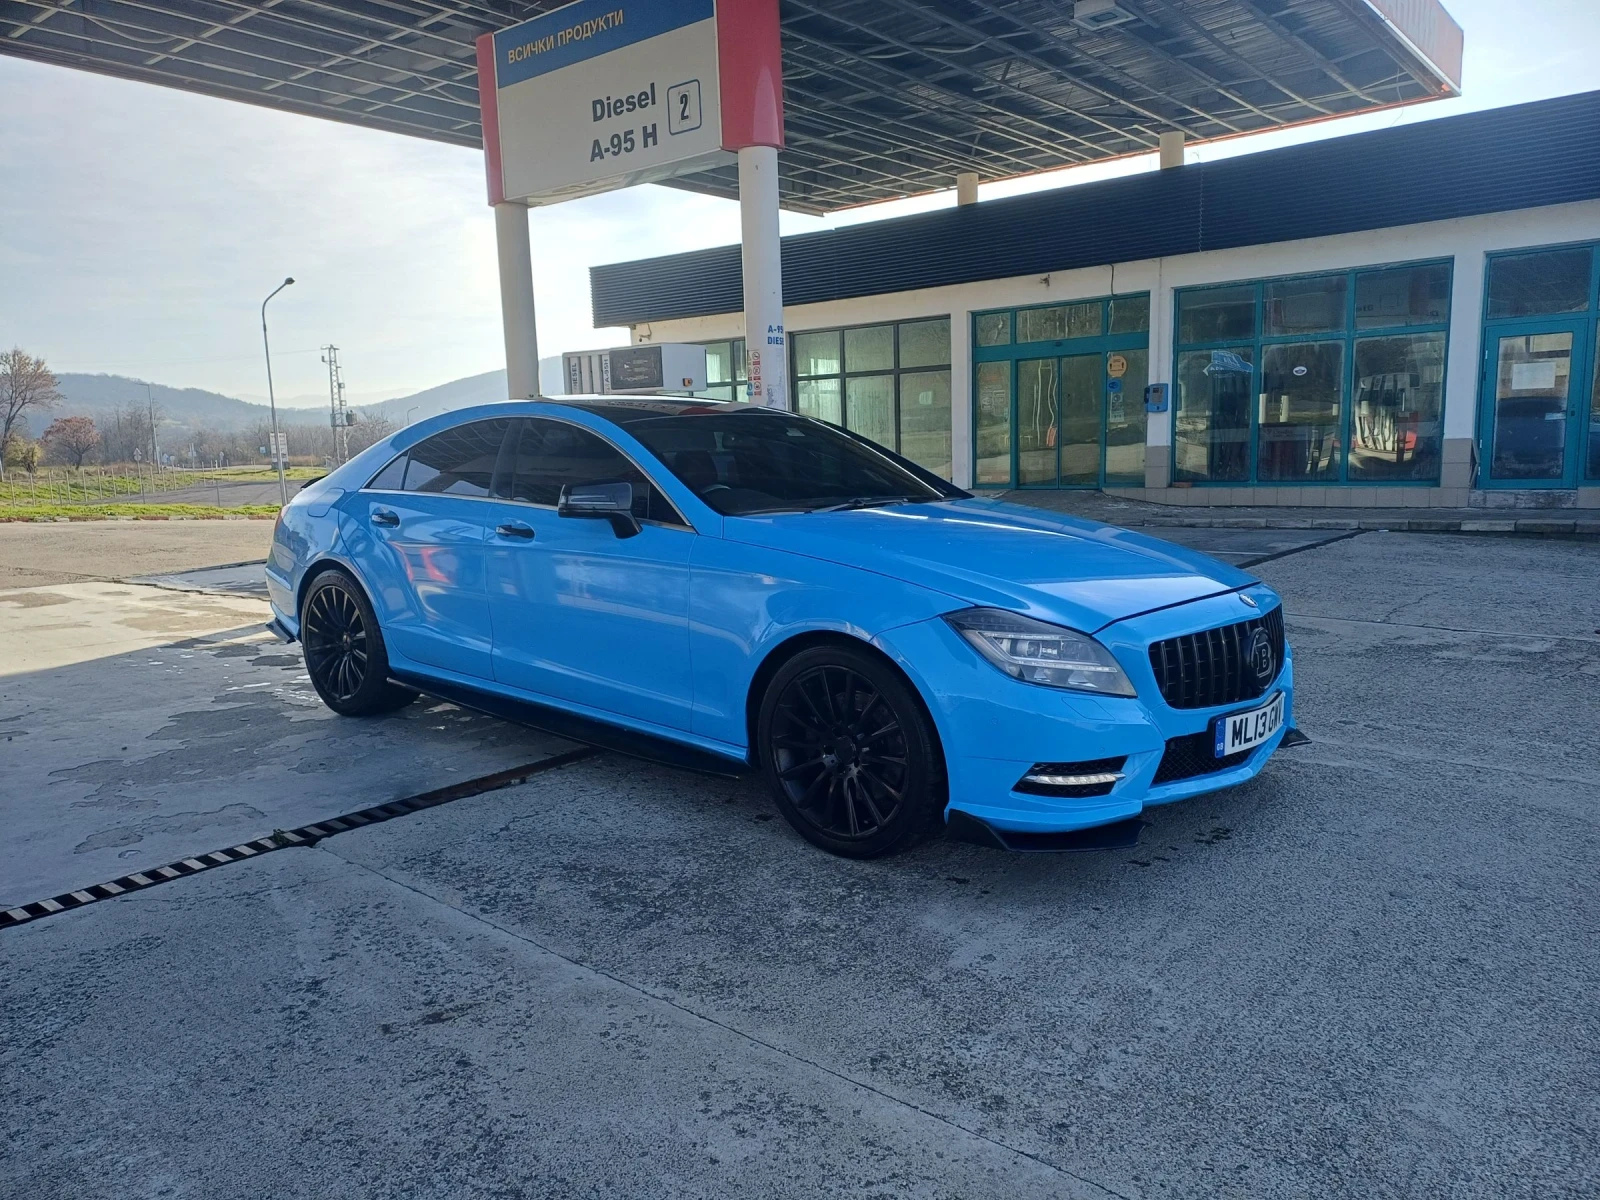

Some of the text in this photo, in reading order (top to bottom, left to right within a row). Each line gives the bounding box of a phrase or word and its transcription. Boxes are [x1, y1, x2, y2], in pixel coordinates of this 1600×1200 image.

[508, 9, 624, 64] ВСИЧКИ ПРОДУКТИ
[592, 82, 656, 122] Diesel
[680, 93, 689, 120] 2
[590, 123, 658, 162] A-95 H
